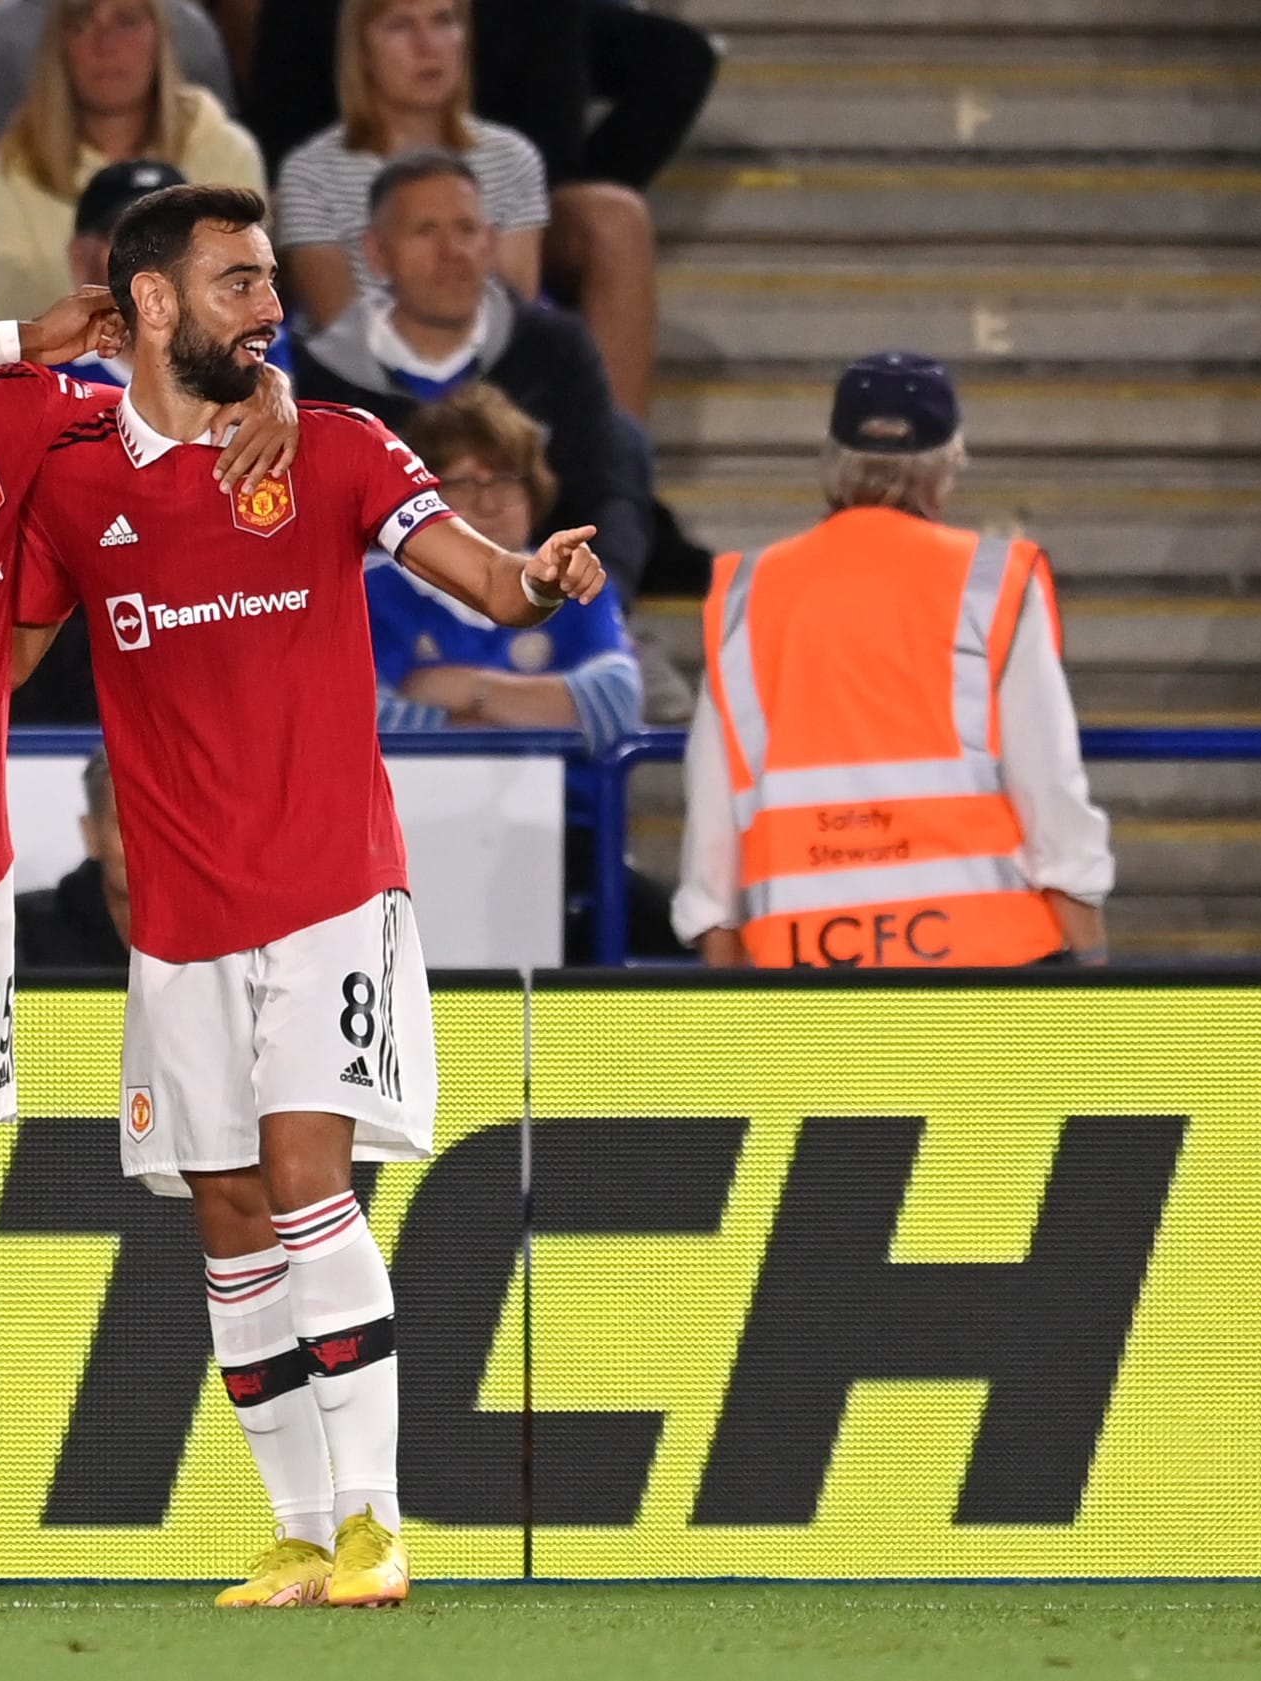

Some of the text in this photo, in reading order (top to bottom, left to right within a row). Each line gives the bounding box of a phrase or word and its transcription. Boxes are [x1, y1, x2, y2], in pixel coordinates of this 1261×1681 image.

[413, 498, 443, 513] Ca
[99, 532, 139, 548] adidas
[147, 588, 310, 632] TeamViewer
[817, 807, 894, 833] Safety
[808, 839, 910, 867] Steward
[788, 909, 952, 968] LCFC
[340, 971, 376, 1049] 8
[340, 1073, 374, 1088] adidas
